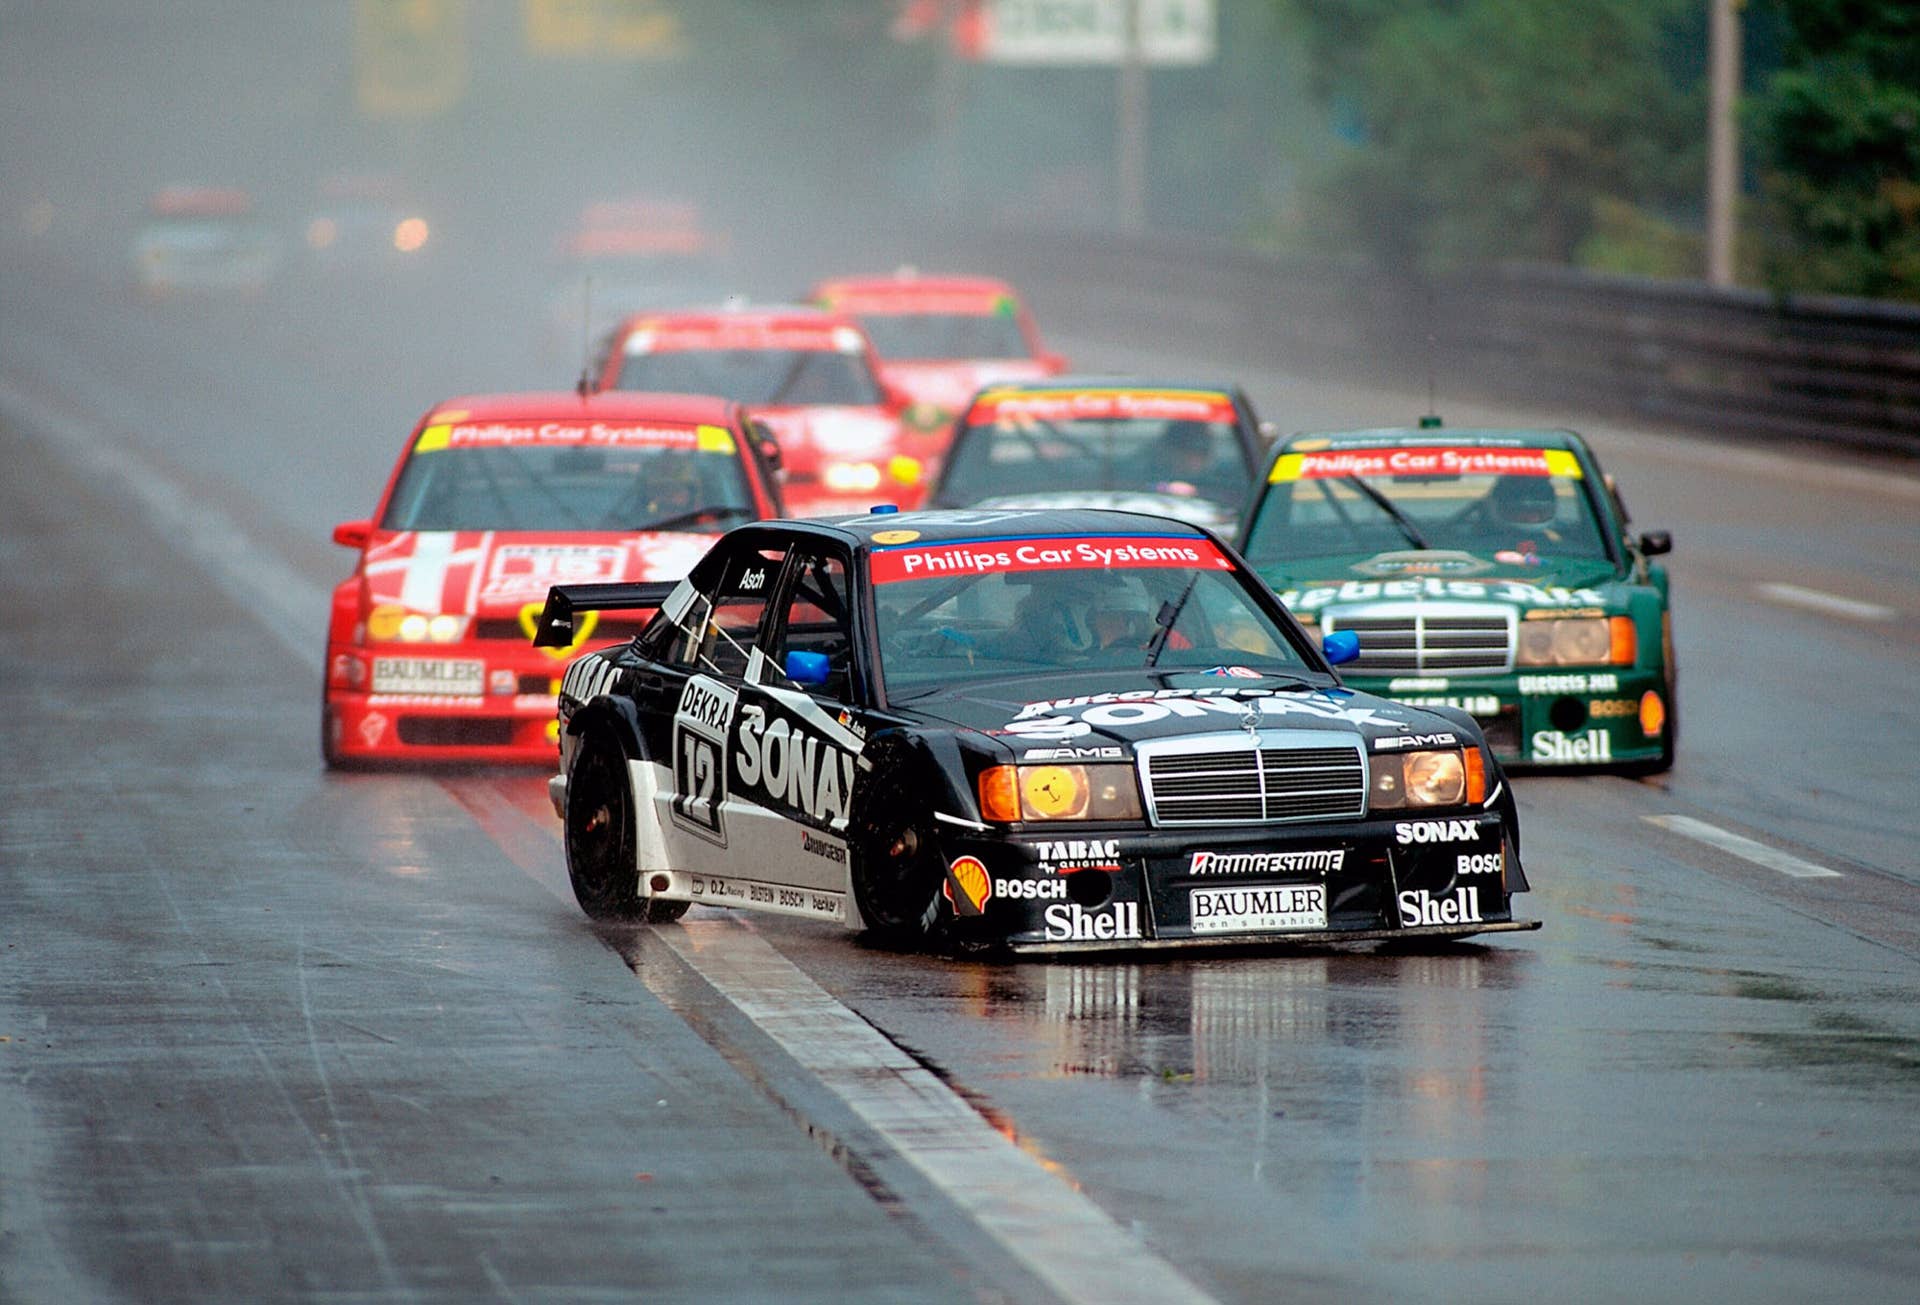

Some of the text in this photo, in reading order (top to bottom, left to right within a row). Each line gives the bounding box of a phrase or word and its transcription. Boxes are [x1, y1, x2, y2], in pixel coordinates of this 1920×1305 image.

[452, 423, 697, 445] Philips Car Systems
[1300, 451, 1548, 473] Philips Car Systems
[903, 543, 1200, 572] Philips Car Systems
[739, 567, 765, 590] Asch
[681, 682, 730, 734] DEKRA
[1003, 696, 1409, 739] SONAX
[1399, 733, 1457, 748] AMG
[1531, 728, 1612, 765] Shell
[1052, 747, 1123, 760] AMG
[684, 733, 715, 826] 12
[1395, 819, 1480, 844] SONAX
[1036, 840, 1120, 860] TABAC
[1059, 859, 1119, 870] ORIGINAL
[1189, 850, 1345, 877] BRIDGESTONE
[1457, 852, 1502, 875] BOSC
[780, 889, 805, 908] BOSCH
[995, 879, 1067, 899] BOSCH
[1194, 889, 1324, 918] BÄUMLER
[1399, 886, 1483, 927] Shell
[1044, 901, 1142, 940] Shell
